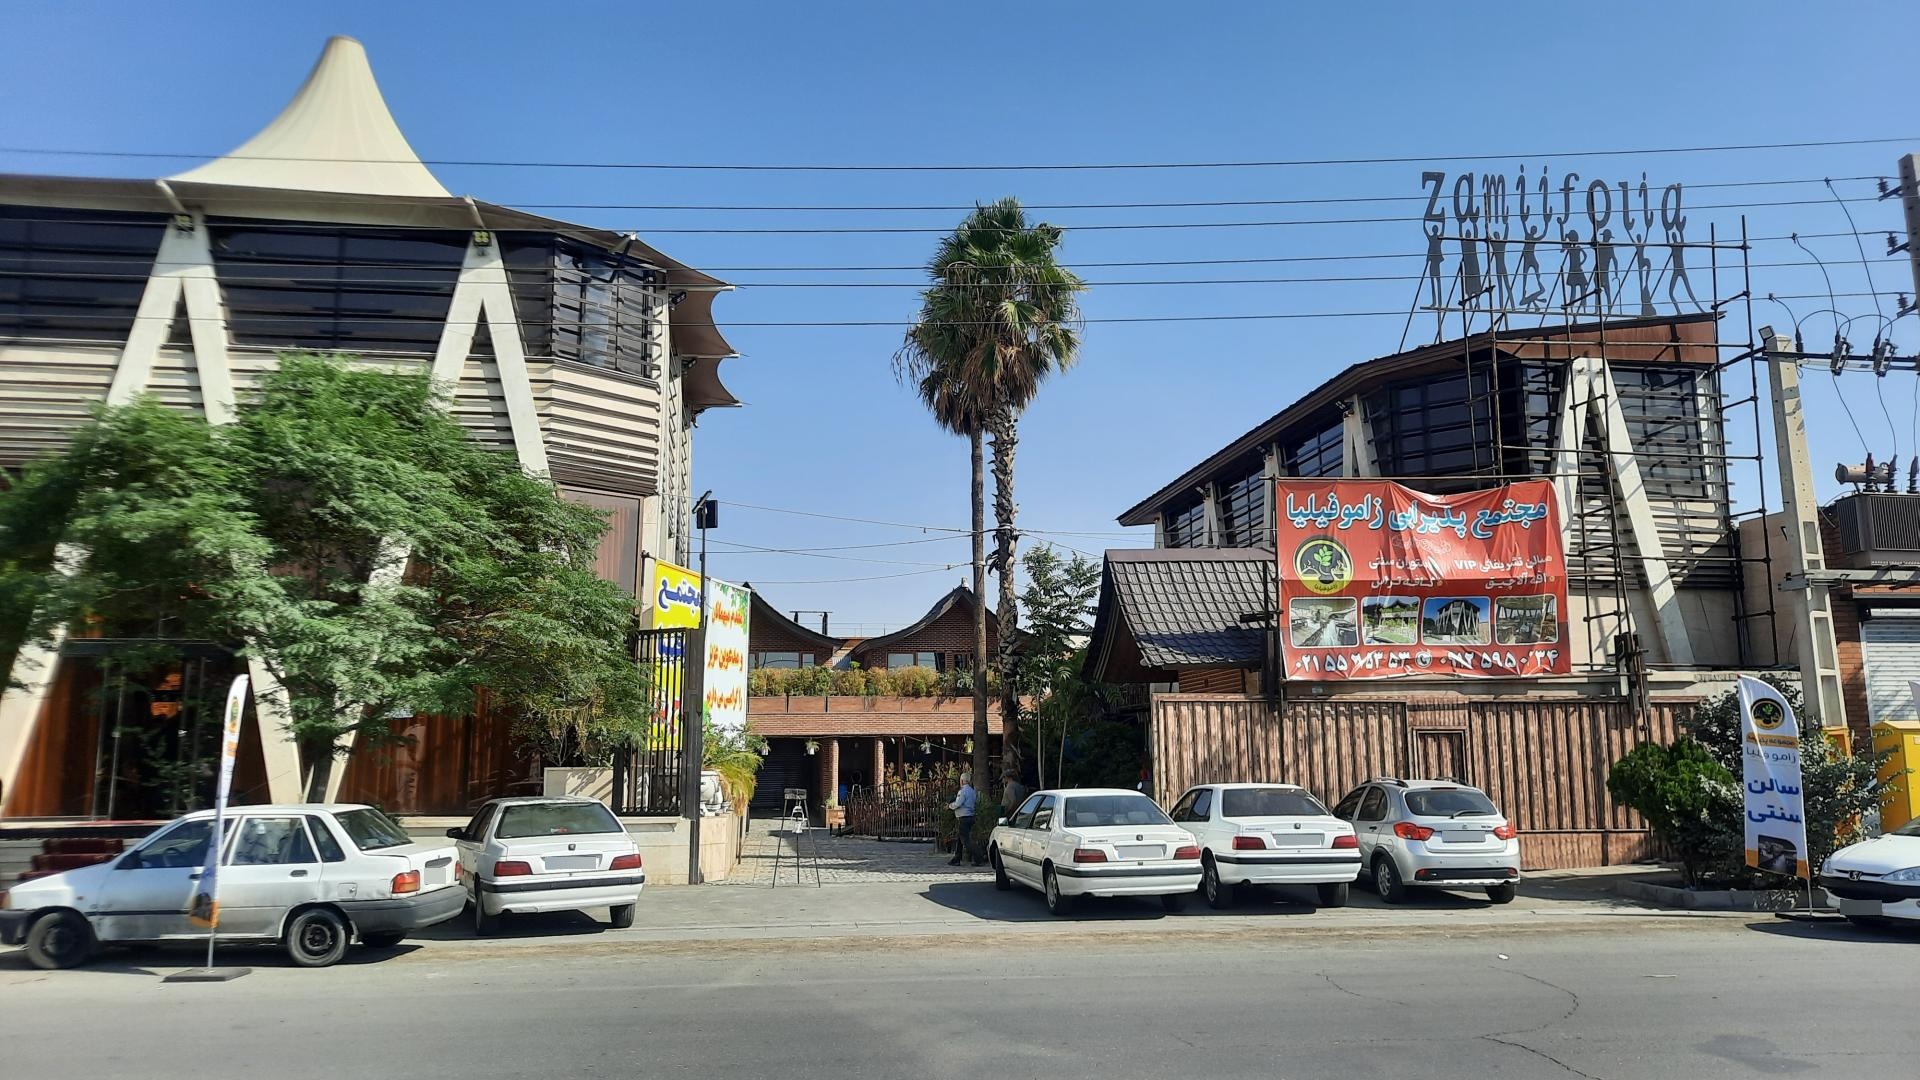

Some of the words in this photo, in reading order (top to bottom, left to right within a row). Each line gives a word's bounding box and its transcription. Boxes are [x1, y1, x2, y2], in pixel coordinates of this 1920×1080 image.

[1286, 492, 1384, 530] زاموفیلیا
[1388, 500, 1466, 539] پذیرایی
[1471, 498, 1548, 539] مجتمع
[1454, 559, 1477, 570] VIP
[1296, 654, 1320, 673] ۰۲۱
[1324, 653, 1348, 672] ۵۵
[1747, 778, 1799, 796] سالن
[1747, 804, 1802, 823] سنتی
